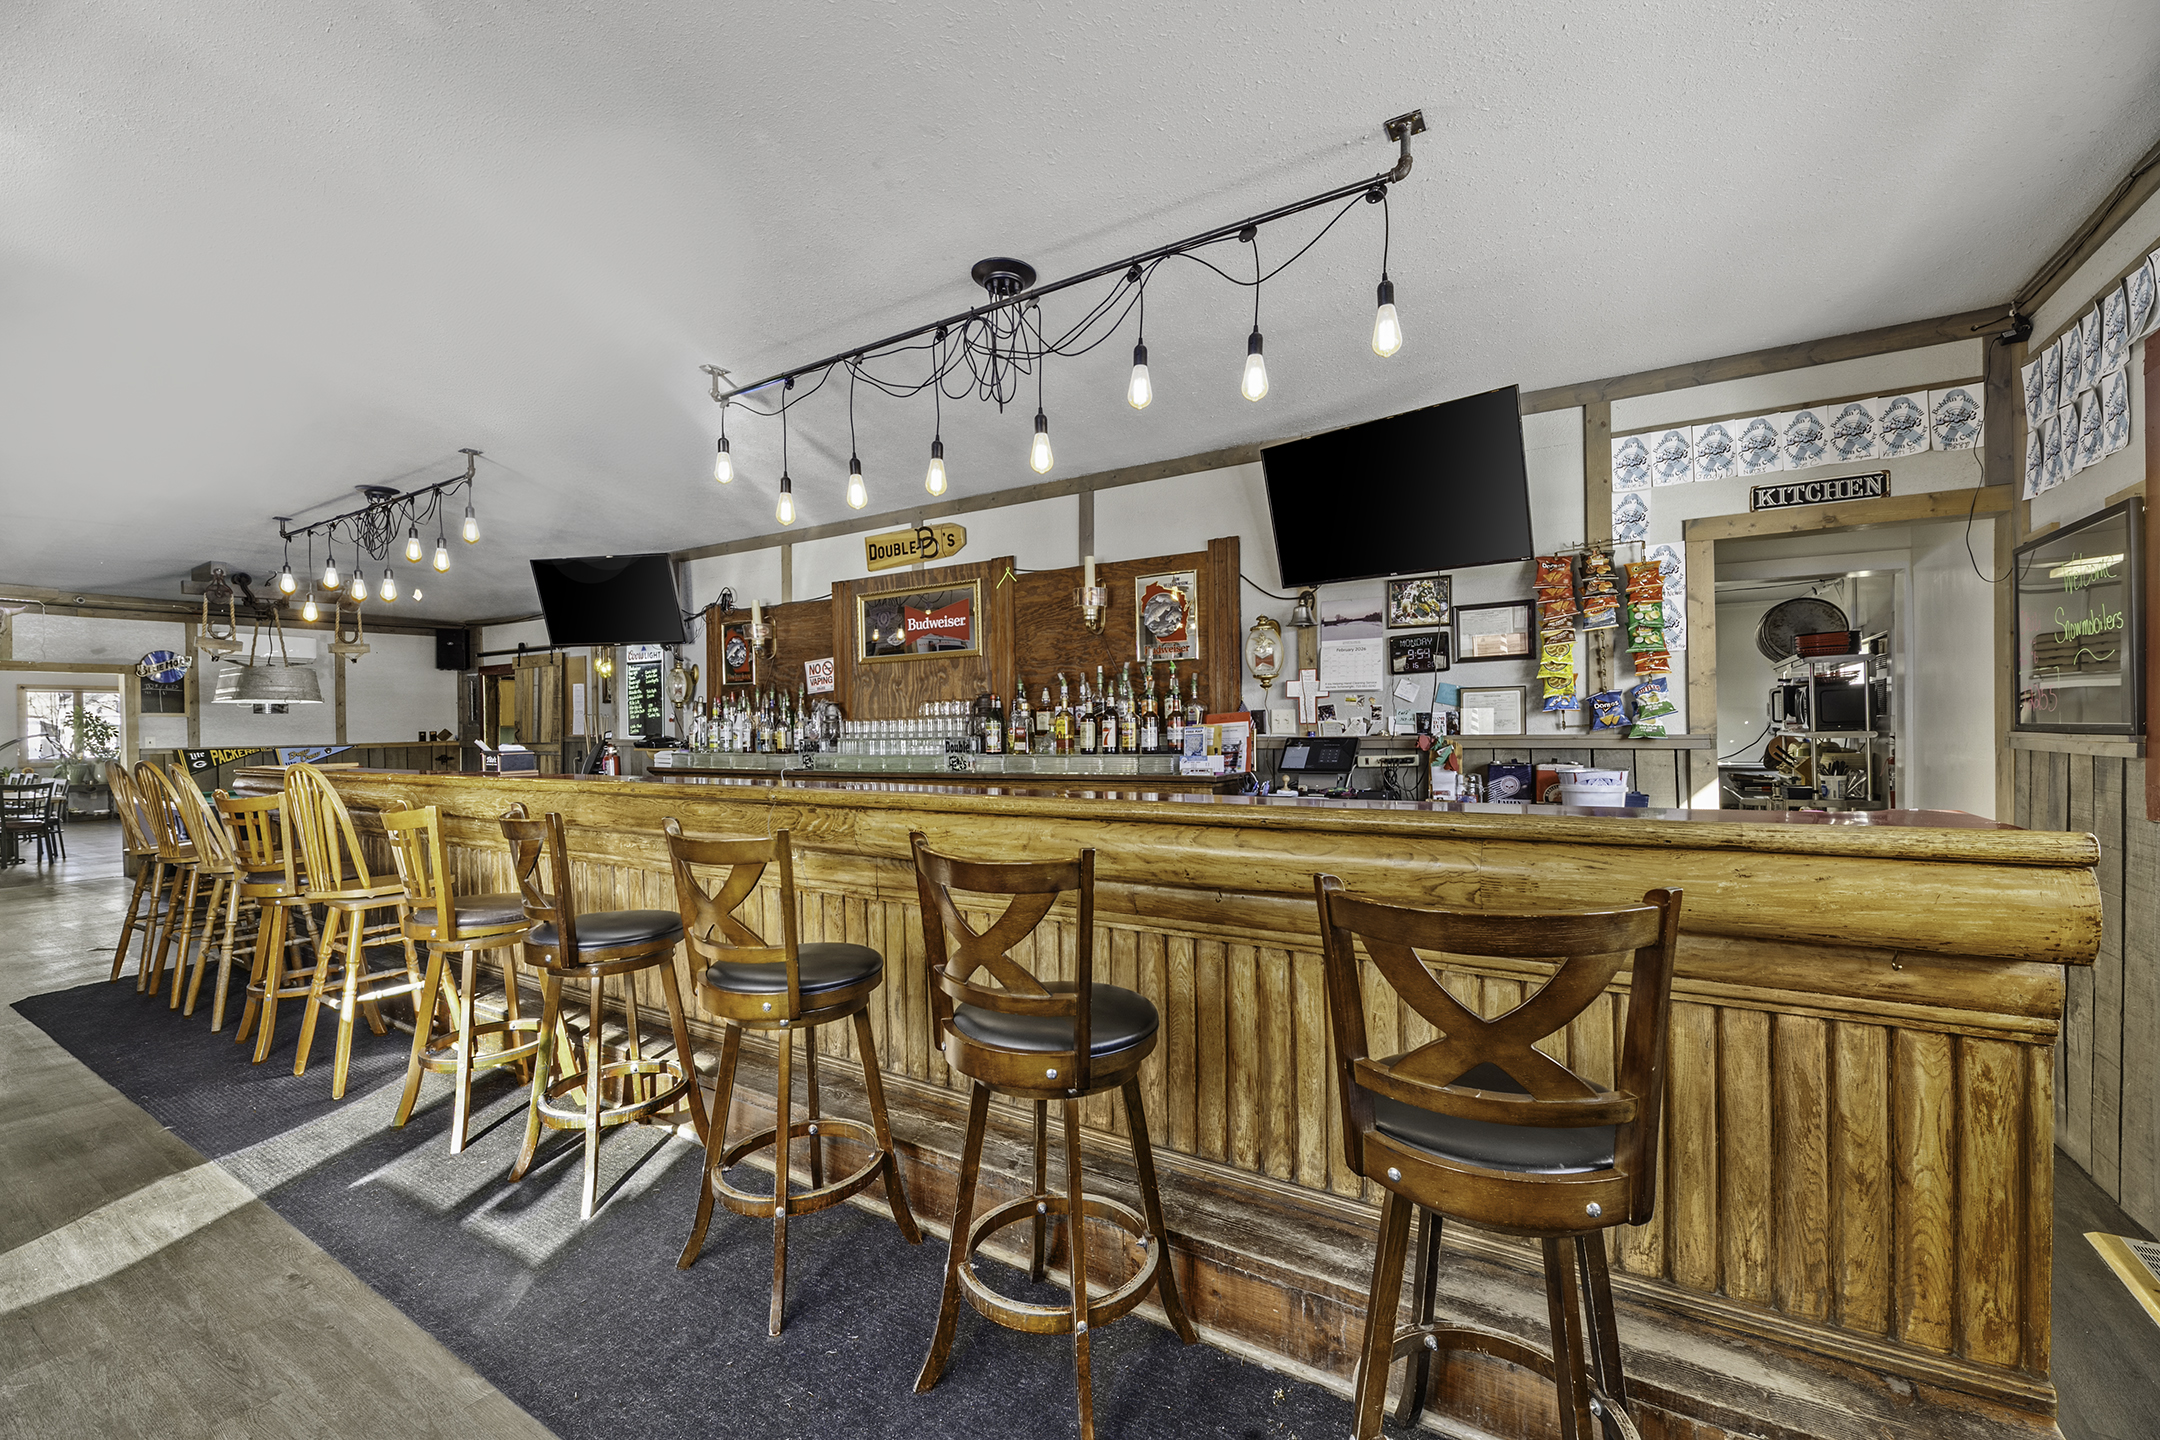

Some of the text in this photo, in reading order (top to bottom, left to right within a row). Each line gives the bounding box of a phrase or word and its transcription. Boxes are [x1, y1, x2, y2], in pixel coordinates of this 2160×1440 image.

[1906, 424, 1928, 447] Cancer
[1959, 419, 1983, 440] Cancer
[1808, 439, 1828, 459] Cancer
[1856, 432, 1877, 453] Cancer
[1717, 451, 1736, 471] Cancer
[1762, 445, 1781, 466] Cancer
[1633, 463, 1651, 482] Cancer
[1675, 457, 1693, 476] Cancer
[1756, 475, 1883, 508] KITCHEN
[1632, 520, 1649, 539] Cancer
[1665, 573, 1684, 591] Cancer
[2062, 552, 2117, 594] Welcome
[907, 615, 966, 632] Budweiser
[2054, 603, 2124, 644] Snowmobilers
[1400, 637, 1433, 648] MONDAY
[644, 651, 661, 660] LIGHT
[809, 663, 821, 676] NO
[809, 676, 833, 687] VAPING
[1594, 701, 1619, 709] Doritos
[946, 741, 969, 753] Double
